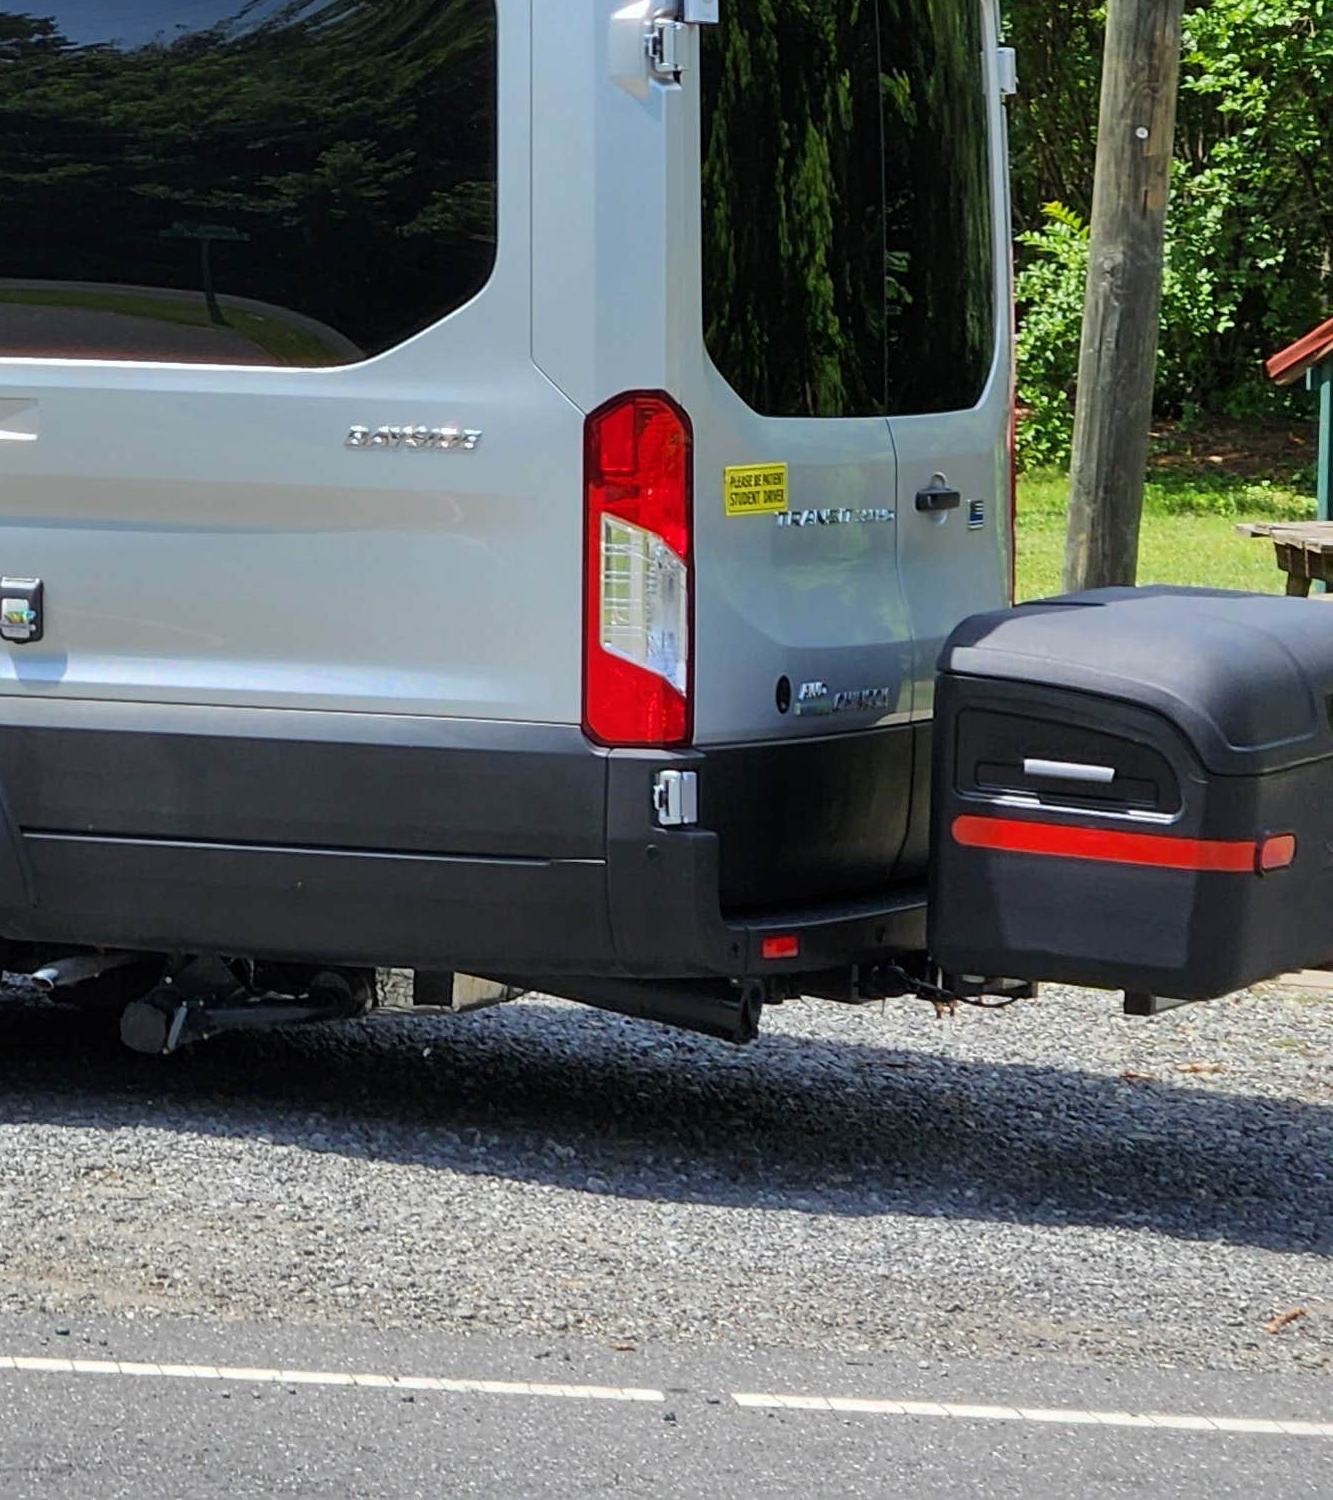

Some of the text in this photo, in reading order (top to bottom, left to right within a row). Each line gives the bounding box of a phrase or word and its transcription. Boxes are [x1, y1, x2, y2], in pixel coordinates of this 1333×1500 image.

[730, 474, 753, 488] PLEASE
[730, 489, 784, 506] STUDENT DRIVER
